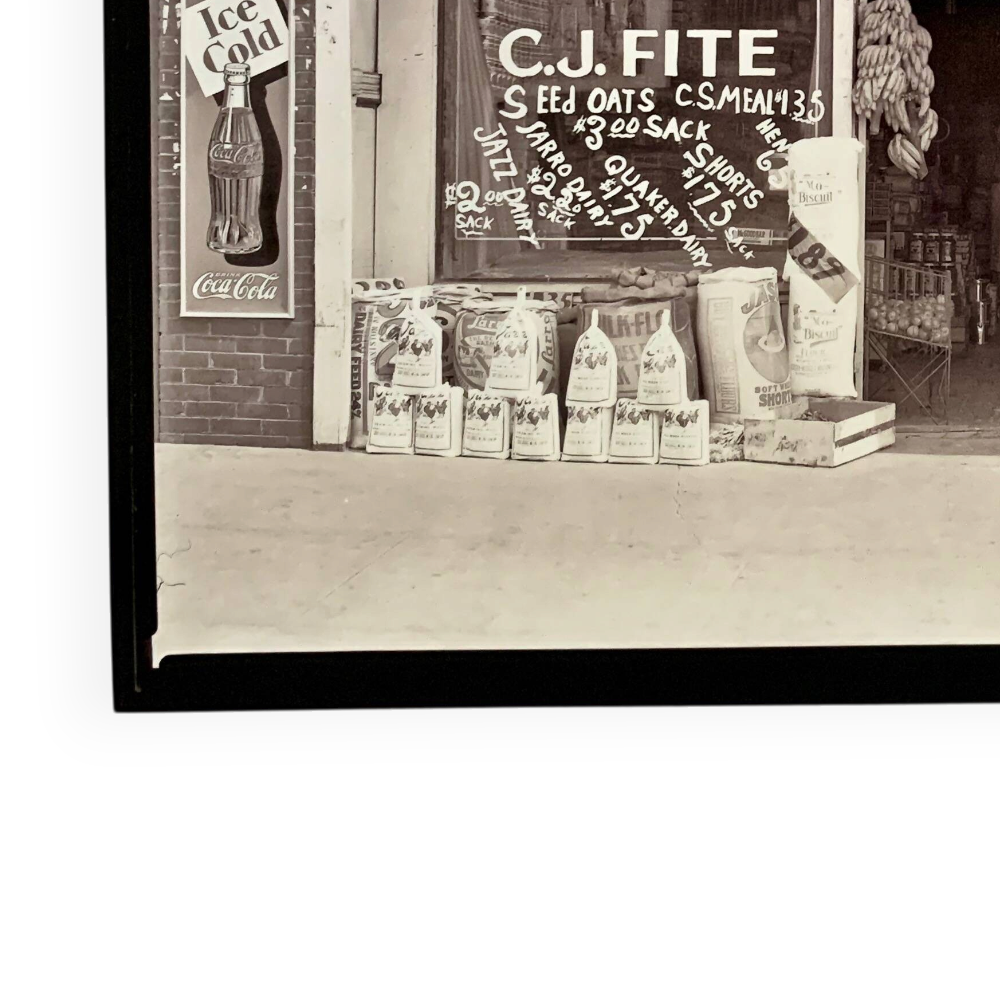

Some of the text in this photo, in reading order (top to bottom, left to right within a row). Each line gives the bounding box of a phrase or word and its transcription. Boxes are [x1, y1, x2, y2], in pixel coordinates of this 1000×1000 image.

[197, 0, 258, 39] Ice
[203, 18, 284, 73] Cold
[623, 29, 778, 77] FITE
[587, 86, 655, 113] OATS
[643, 115, 711, 142] SACK
[473, 123, 542, 250] JAZZ DAIRY
[683, 142, 765, 210] SHORTS
[538, 202, 576, 230] SACK
[566, 176, 614, 227] DAIRY
[455, 213, 494, 230] SACK
[672, 219, 713, 268] DAIRY
[724, 226, 756, 261] SACK
[741, 281, 779, 314] JAS
[350, 312, 367, 354] DAIRY
[350, 356, 361, 390] FEED
[755, 384, 777, 394] SOFT
